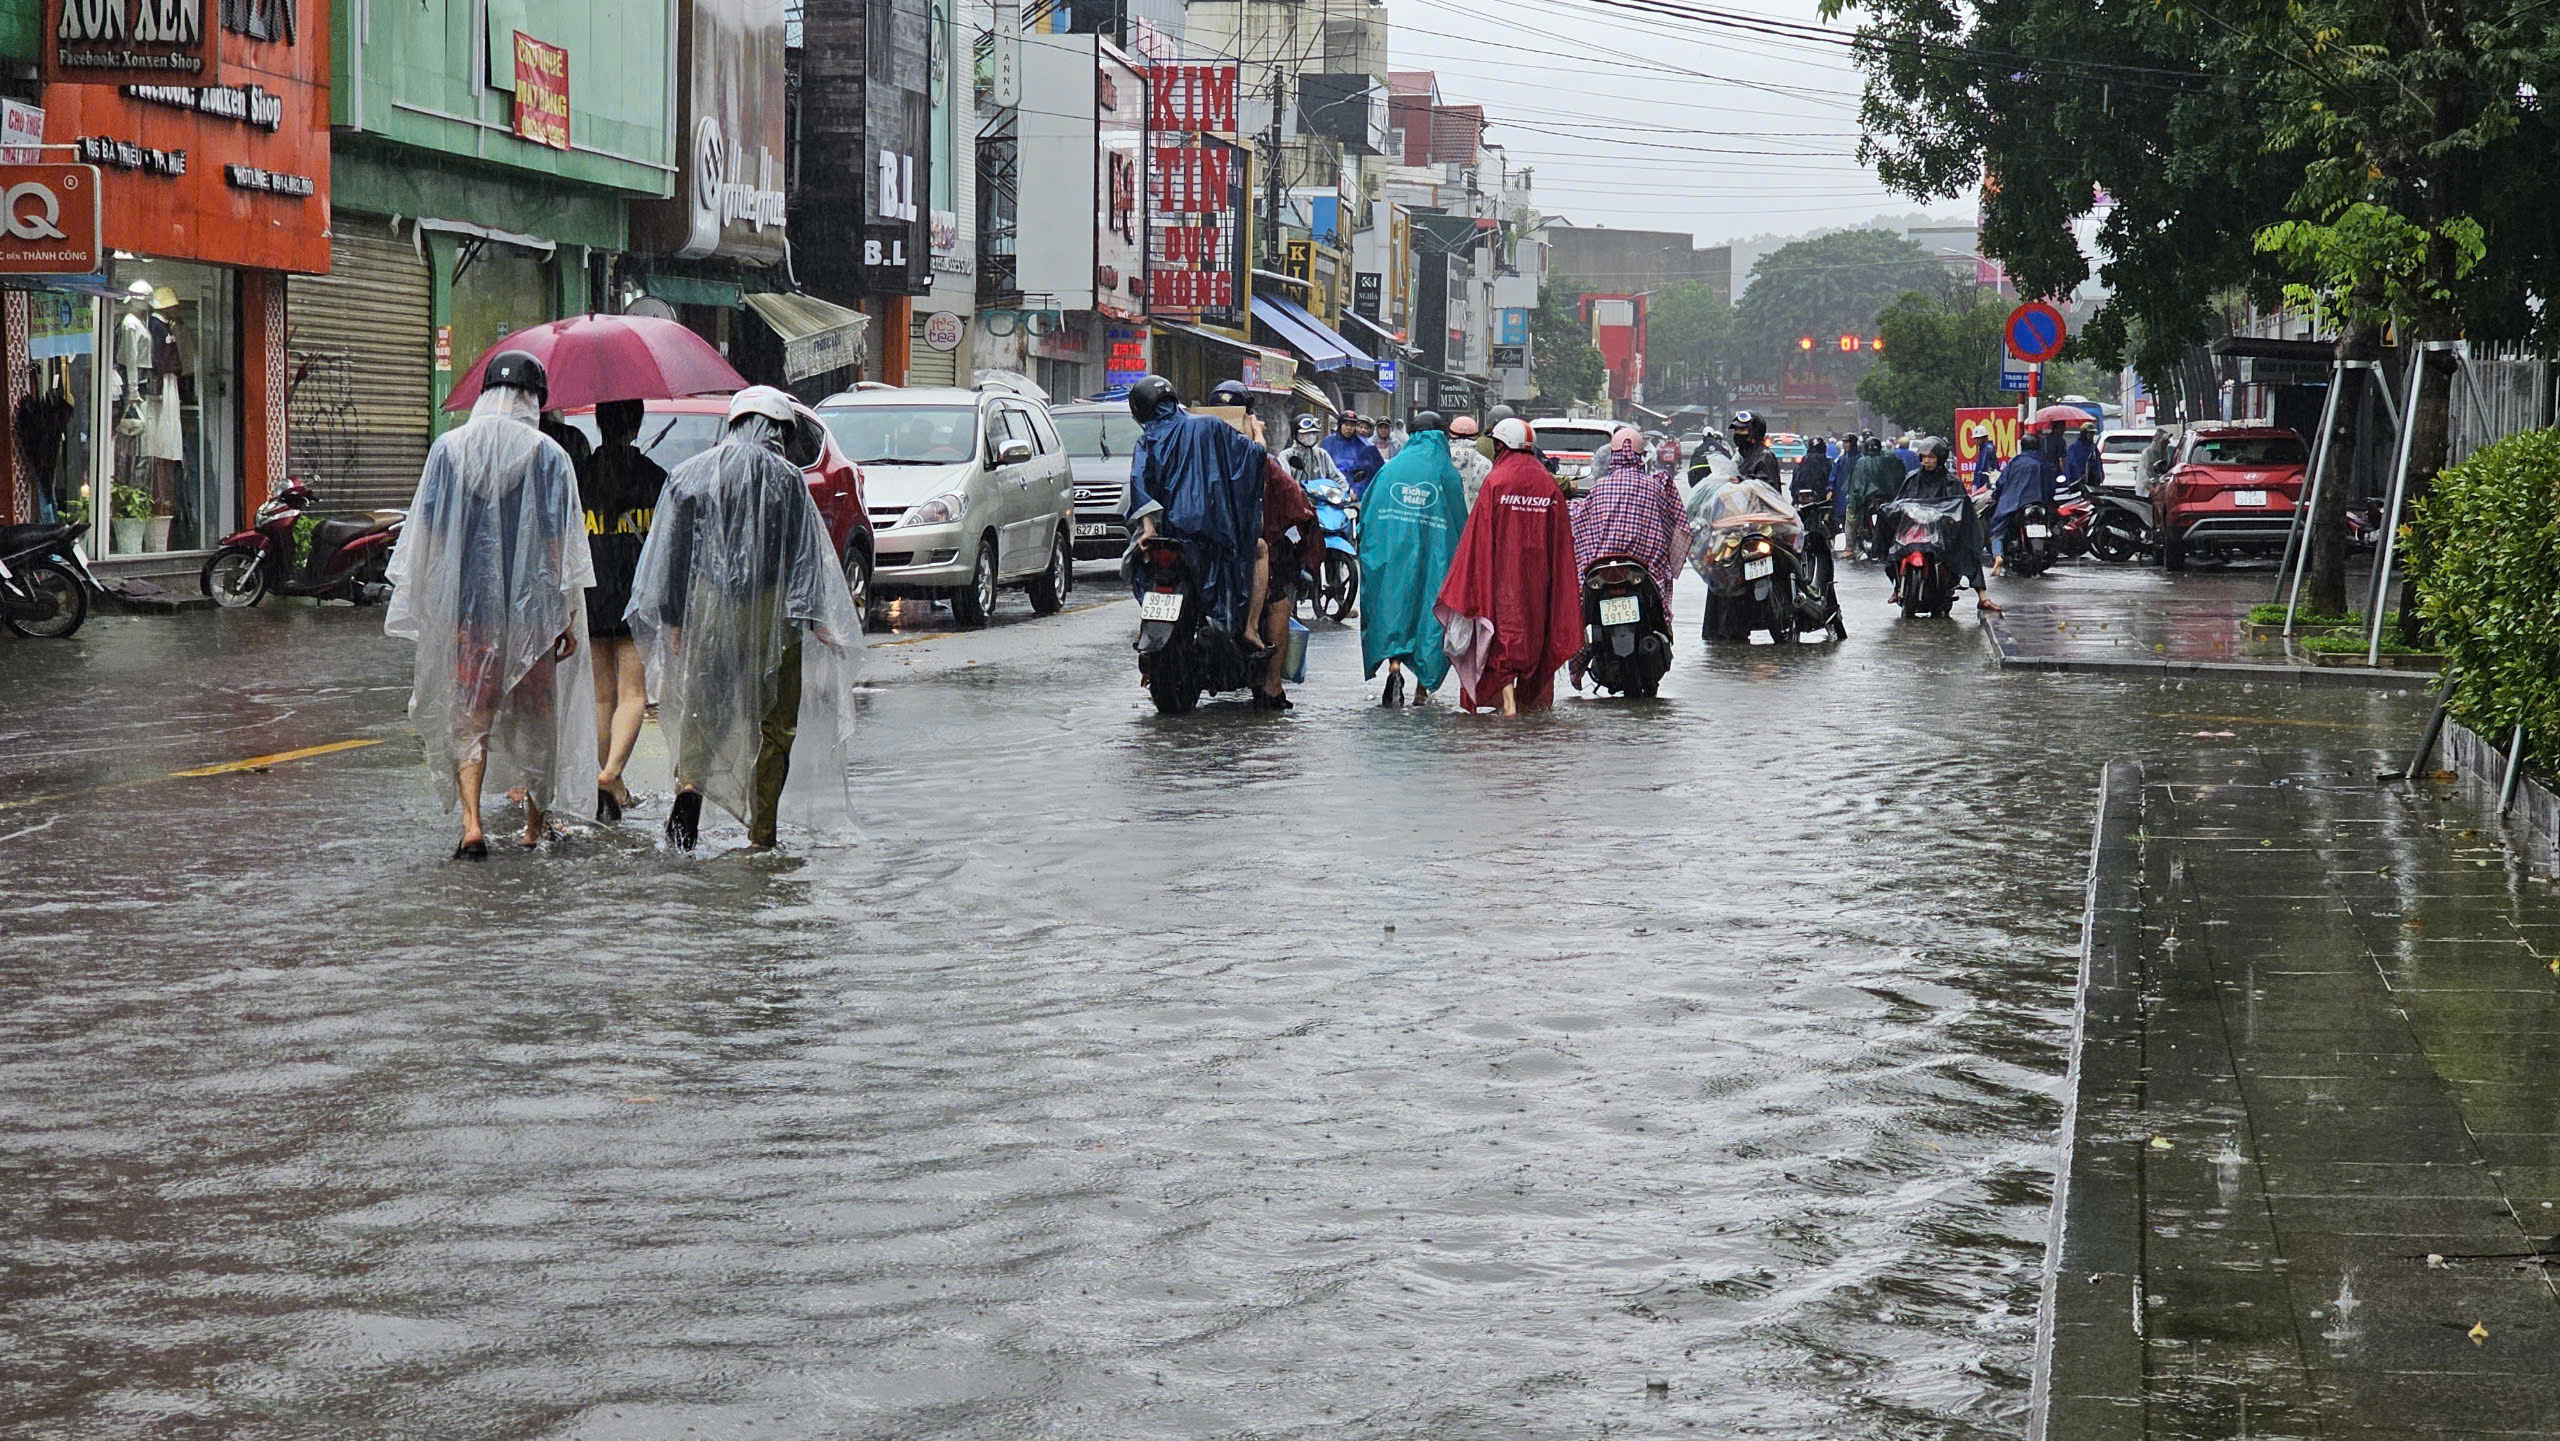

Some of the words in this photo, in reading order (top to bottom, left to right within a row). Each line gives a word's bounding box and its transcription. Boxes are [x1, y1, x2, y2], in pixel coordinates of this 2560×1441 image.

[59, 50, 120, 67] Facebook:
[122, 51, 168, 68] Xonxen
[170, 52, 201, 71] Shop
[250, 86, 281, 132] Shop
[1150, 66, 1236, 131] KIM
[8, 109, 24, 133] CHO
[86, 138, 100, 157] 195
[102, 137, 115, 160] BÀ
[234, 167, 270, 188] HOTLINE:
[864, 239, 907, 267] B.L
[1164, 226, 1221, 262] DUY
[22, 249, 57, 261] THÀNH
[58, 249, 87, 261] CÔNG
[929, 329, 956, 343] tea
[1440, 394, 1468, 409] MEN'S
[1500, 494, 1557, 507] HIKVISIO
[1603, 610, 1638, 624] 391.59
